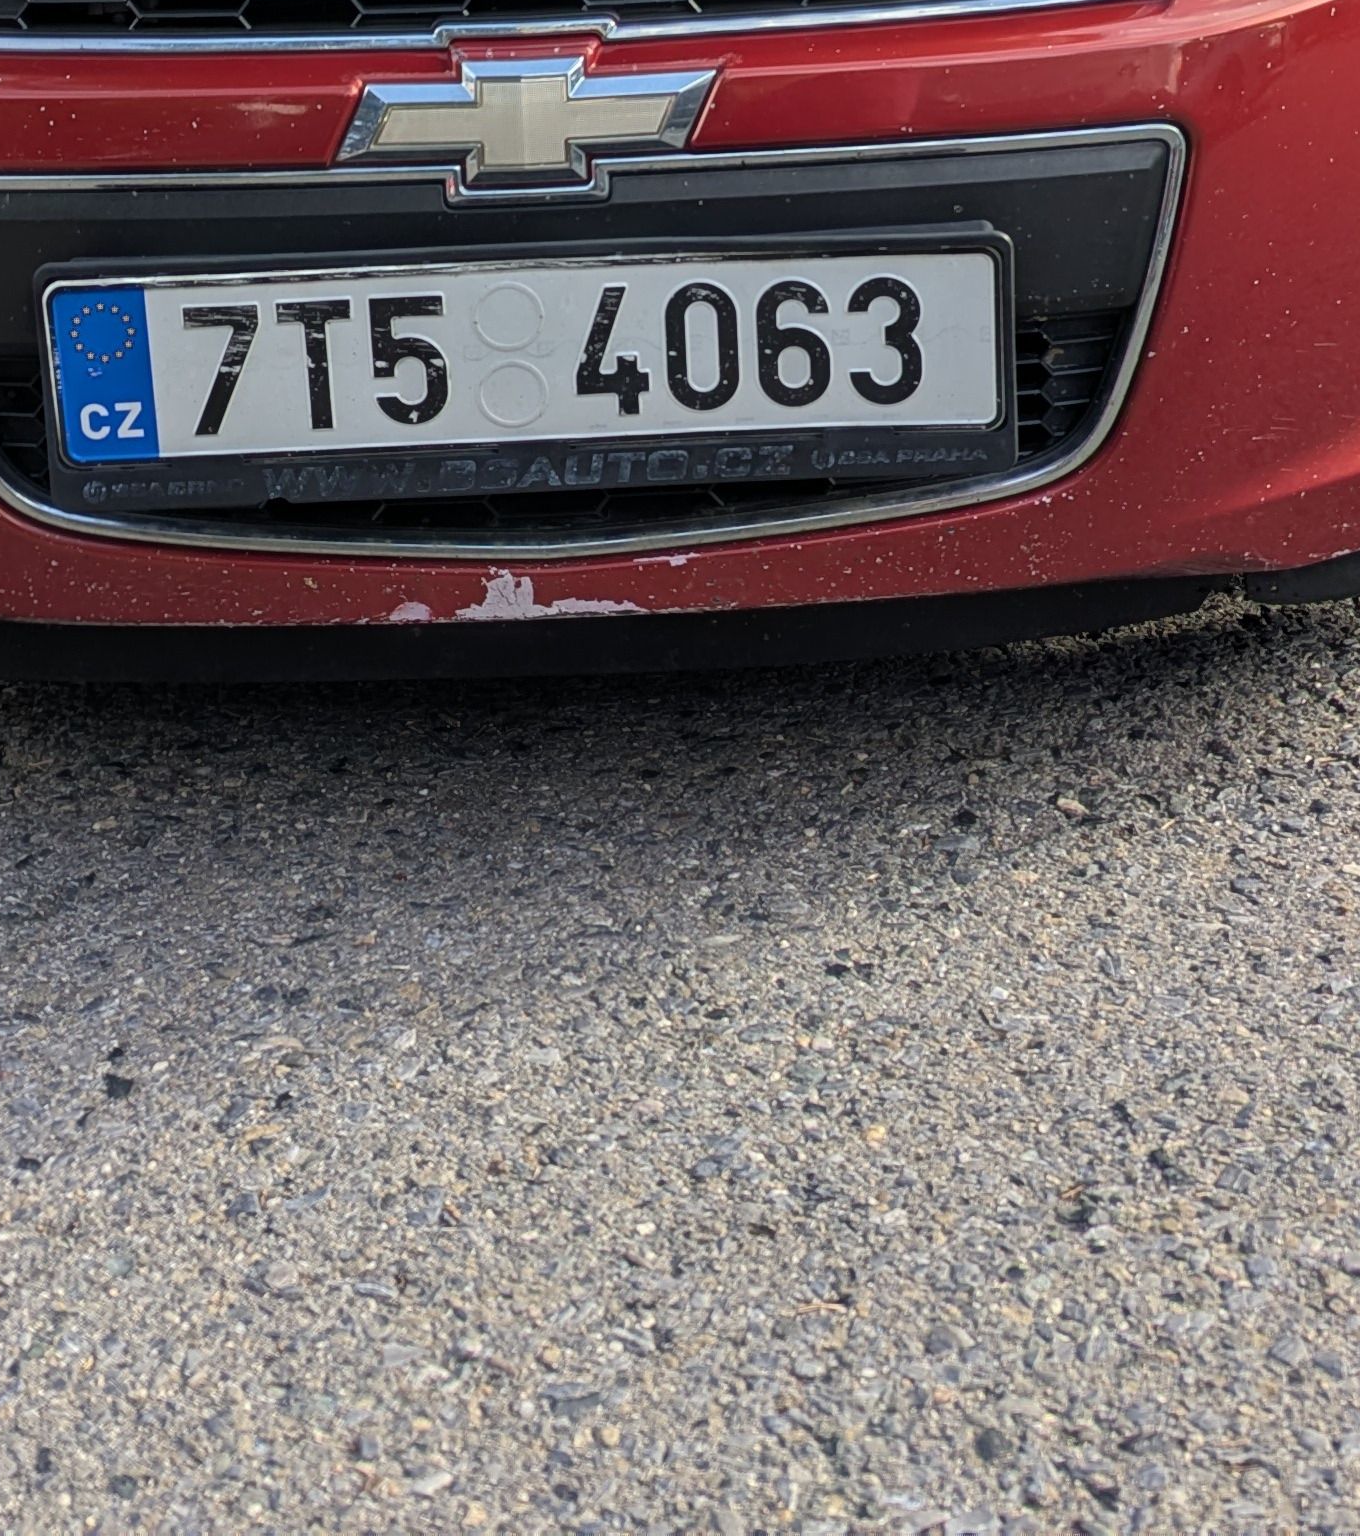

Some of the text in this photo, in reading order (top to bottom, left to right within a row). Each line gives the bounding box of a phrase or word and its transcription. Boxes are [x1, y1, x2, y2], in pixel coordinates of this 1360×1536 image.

[80, 276, 923, 440] CZ 7T5 4063
